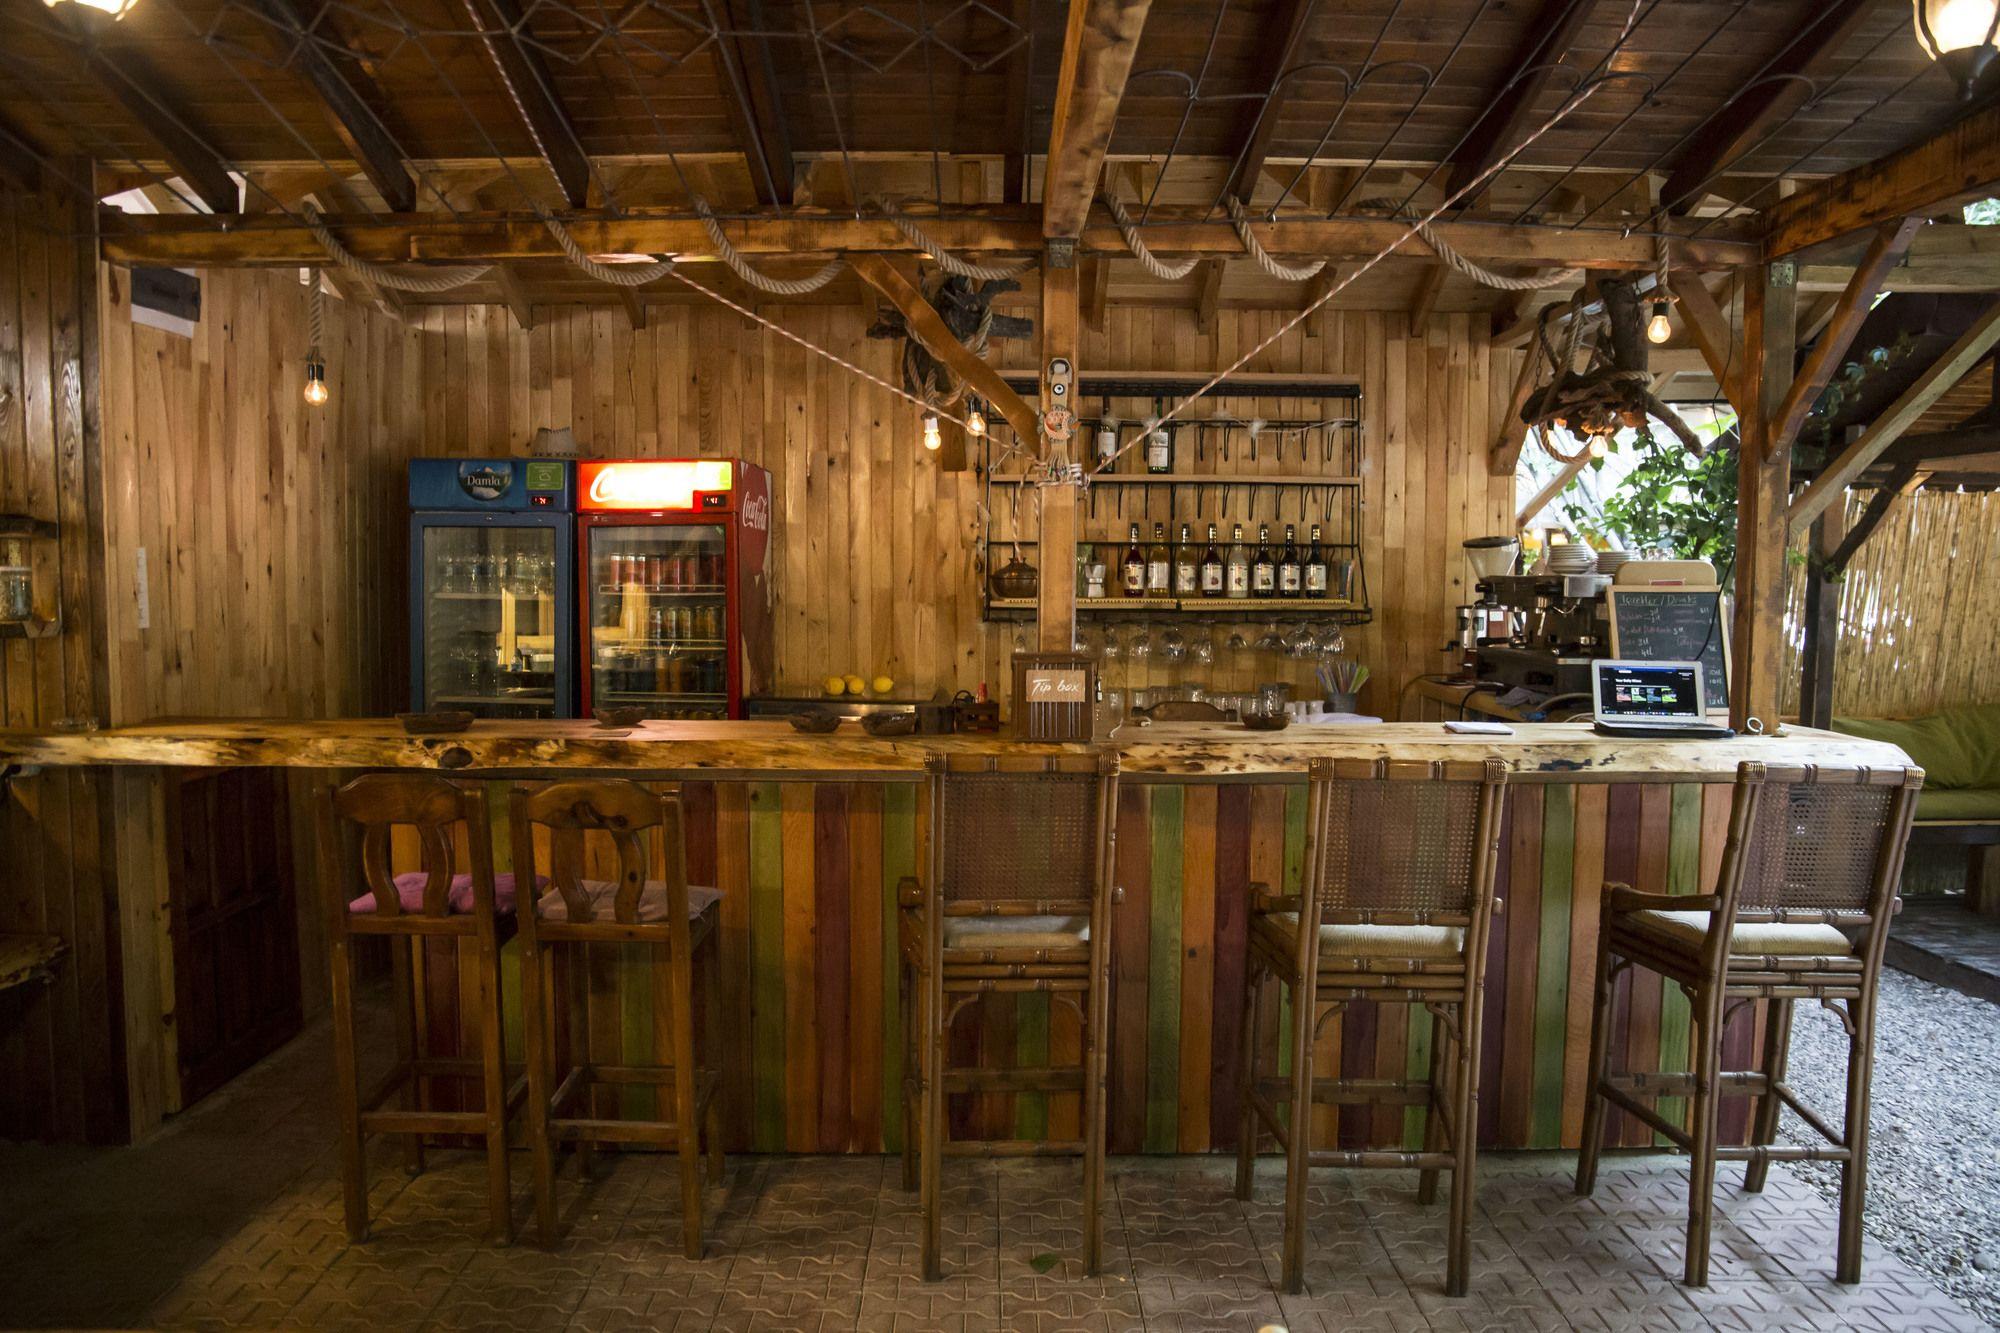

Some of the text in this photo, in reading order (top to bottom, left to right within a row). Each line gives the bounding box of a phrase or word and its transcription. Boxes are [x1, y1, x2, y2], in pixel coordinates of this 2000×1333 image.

[467, 475, 500, 486] Damla
[1031, 679, 1080, 696] Tip box
